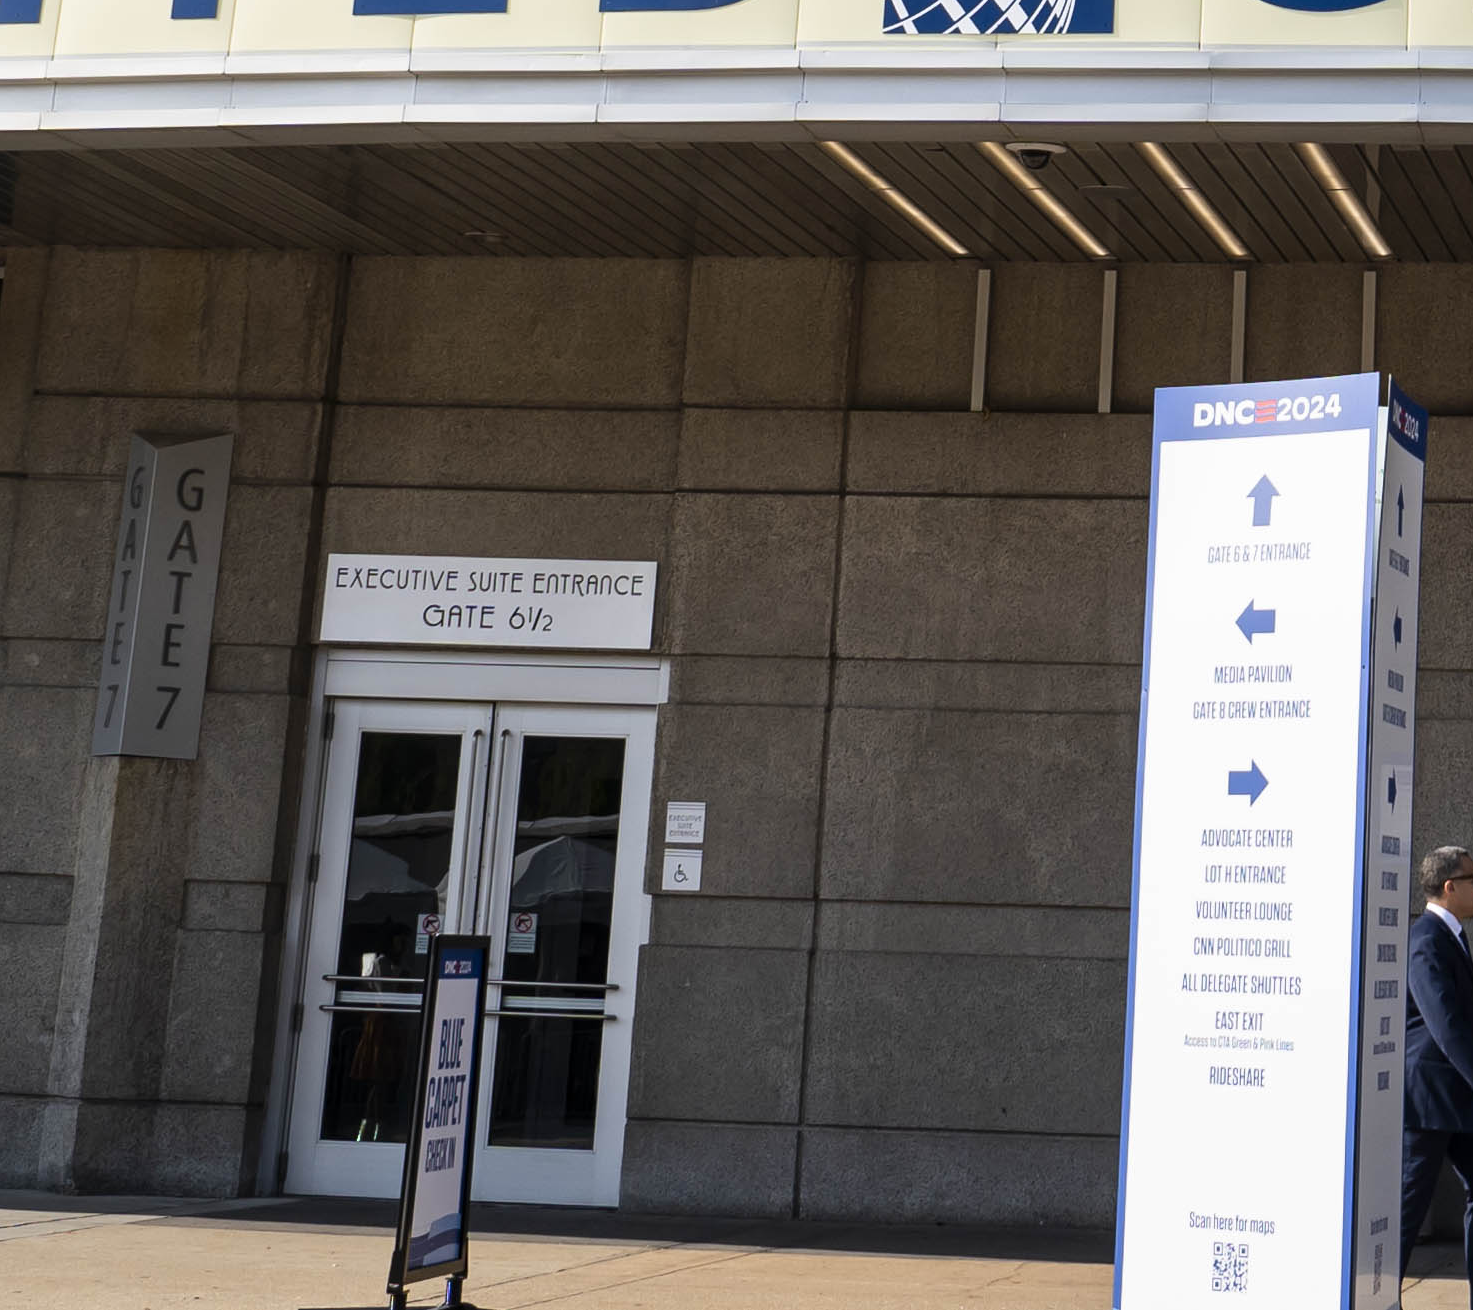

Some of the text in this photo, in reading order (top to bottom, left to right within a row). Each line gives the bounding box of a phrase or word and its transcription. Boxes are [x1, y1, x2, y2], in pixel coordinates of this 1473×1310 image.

[1194, 394, 1342, 426] DNC 2024
[1208, 545, 1231, 563] GATE
[1233, 545, 1240, 562] 6
[1243, 545, 1250, 562] &
[1260, 542, 1311, 561] ENTRANCE
[110, 466, 145, 665] GATE
[336, 567, 644, 596] EXECUTIVE SUITE ENTRANCE
[156, 468, 205, 730] GATE 7
[423, 604, 495, 628] GATE
[1214, 664, 1292, 683] MEDIA PAVILION
[1193, 701, 1216, 719] GATE
[1227, 700, 1256, 718] CREW
[1259, 700, 1311, 718] ENTRANCE
[1201, 829, 1293, 847] ADVOCATE CENTER
[1205, 865, 1285, 883] LOT H ENTRANCE
[1196, 901, 1293, 921] VOLUNTEER LOUNGE
[1193, 937, 1291, 958] CNN POLITICO GRILL
[1182, 973, 1301, 995] ALL DELEGATE SHUTTLES
[1215, 1011, 1263, 1031] EAST EXIT
[438, 1018, 465, 1069] BLUE
[1184, 1035, 1208, 1047] Access
[1210, 1036, 1216, 1047] to
[1218, 1036, 1230, 1049] CTA
[1232, 1036, 1251, 1049] Green
[1260, 1037, 1274, 1050] Pink
[1276, 1038, 1294, 1051] Lines
[1209, 1066, 1265, 1087] RIDESHARE
[425, 1075, 466, 1129] CARPET
[425, 1138, 448, 1173] CHECK
[1189, 1211, 1275, 1235] Scan here for maps
